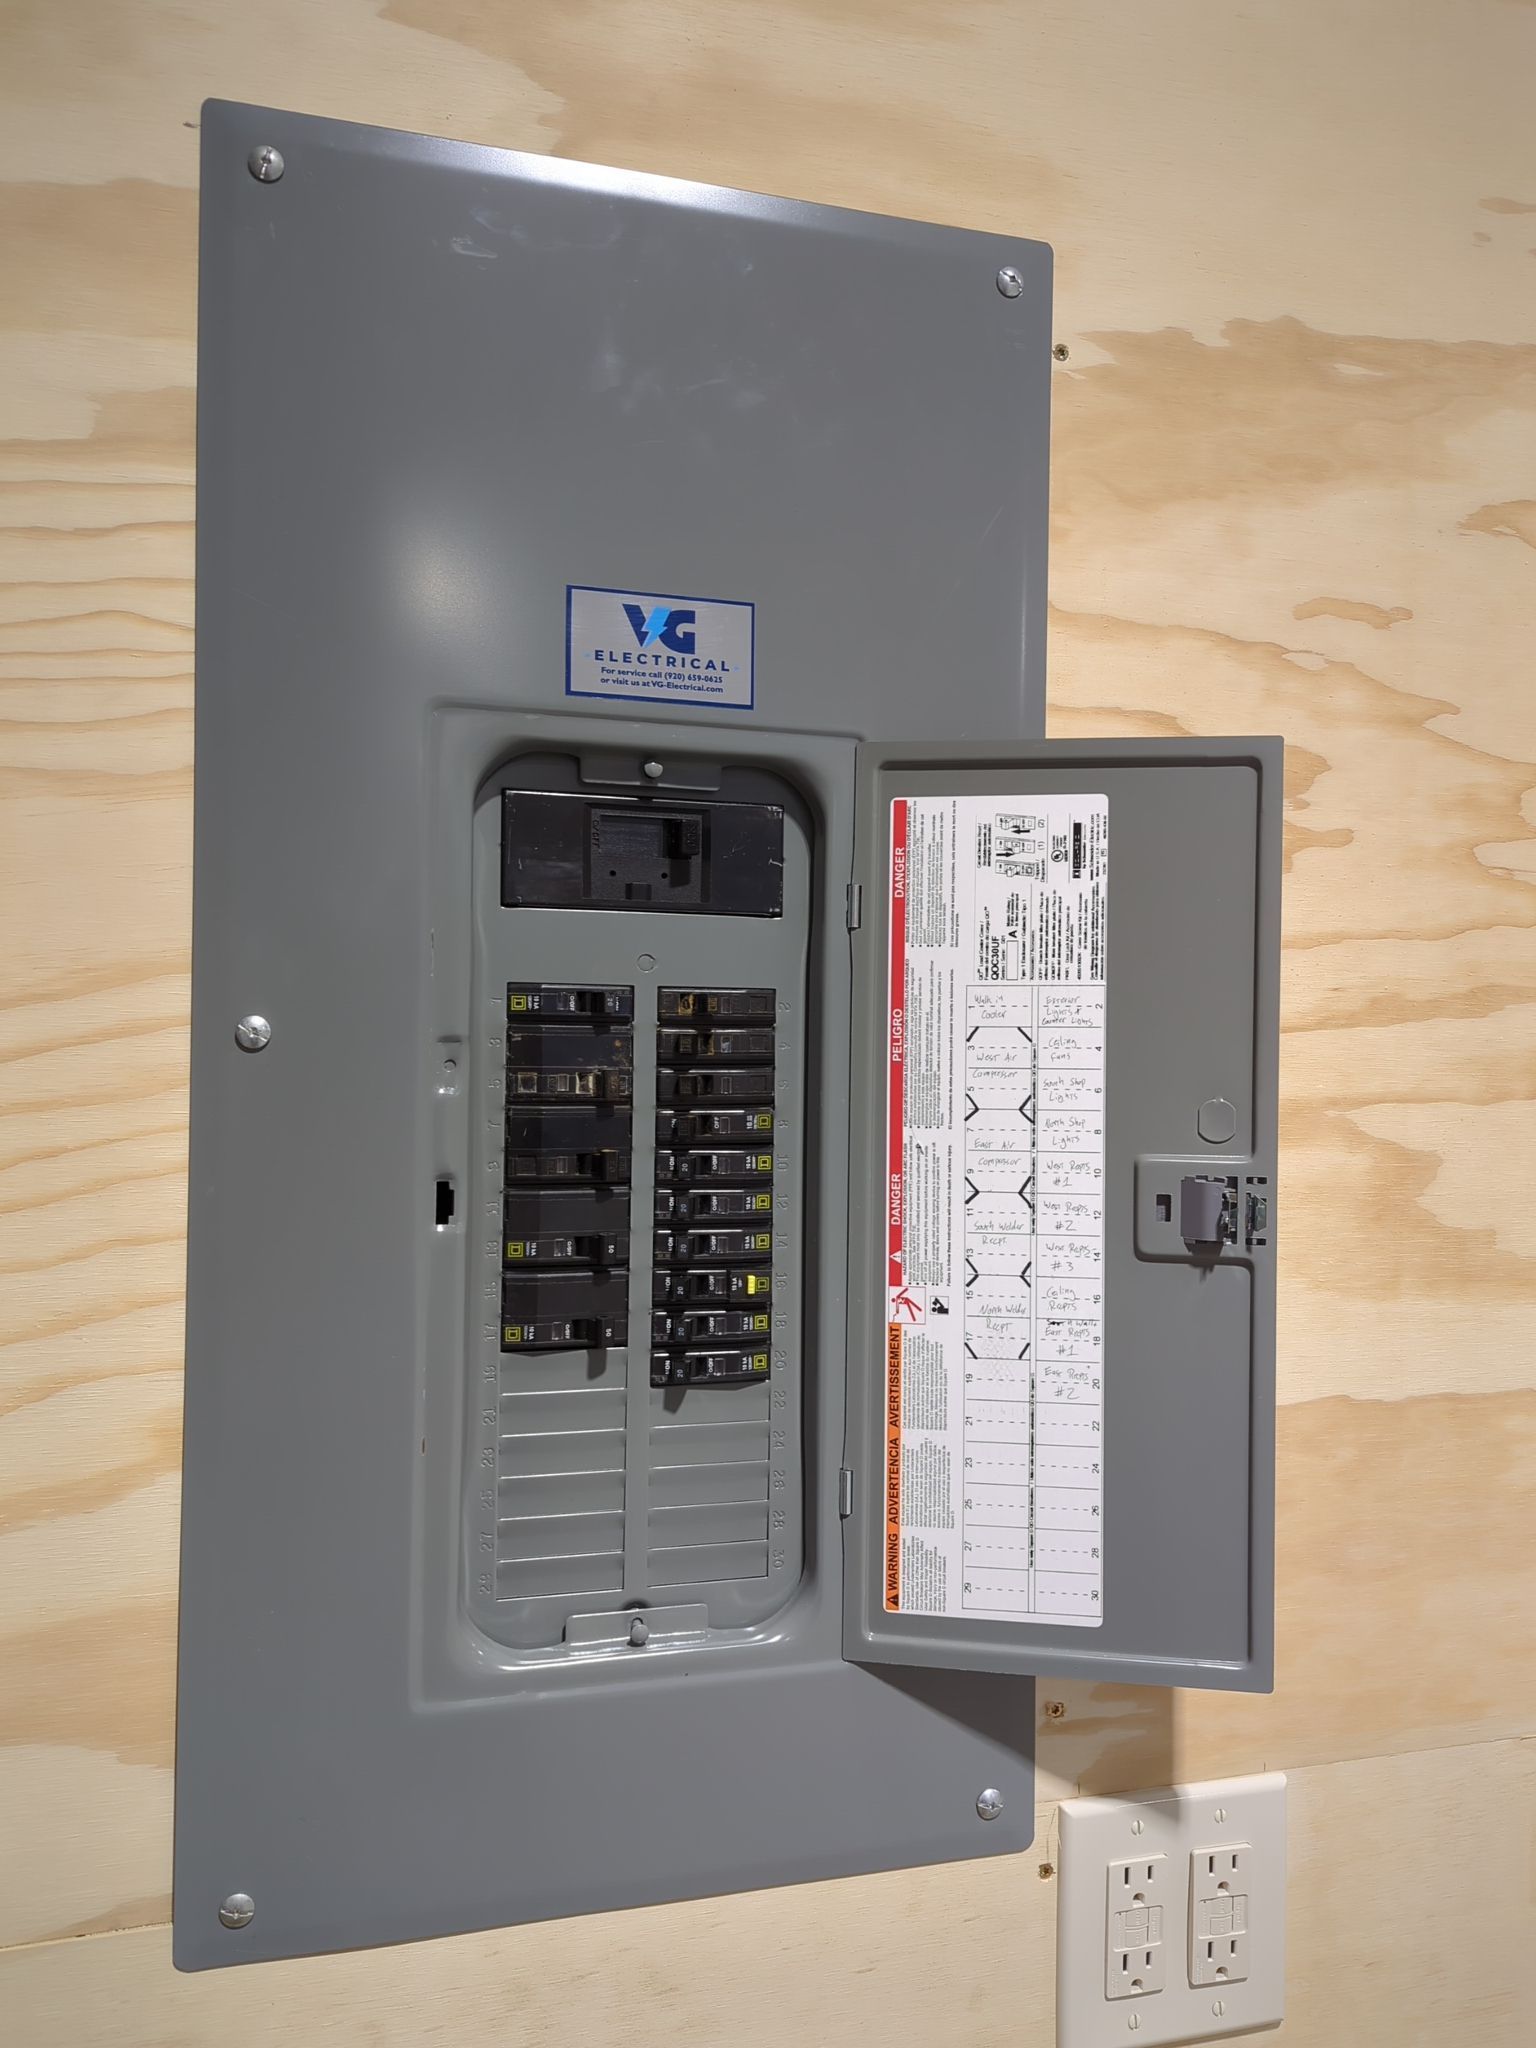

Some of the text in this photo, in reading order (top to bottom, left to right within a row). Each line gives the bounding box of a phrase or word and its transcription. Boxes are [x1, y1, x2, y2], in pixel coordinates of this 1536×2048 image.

[622, 603, 695, 655] VG
[594, 649, 730, 672] ELECTRICAL
[601, 666, 723, 685] For service call (920) 659-0625
[610, 677, 630, 686] visit
[631, 679, 641, 687] us
[641, 680, 651, 688] at
[651, 680, 724, 694] VG-Electrical.com
[1037, 819, 1045, 829] (2)
[1037, 841, 1045, 851] (1)
[894, 847, 905, 898] DANGER
[1008, 930, 1018, 939] A
[991, 935, 1000, 981] QOC30UF
[893, 1008, 903, 1062] PELIGRO
[1094, 1168, 1101, 1178] 10
[891, 1174, 901, 1226] DANGER
[966, 1208, 974, 1217] 11
[1093, 1210, 1101, 1220] 12
[966, 1248, 974, 1258] 13
[1093, 1252, 1101, 1262] 14
[677, 1285, 684, 1295] 20
[966, 1290, 974, 1300] 15
[1093, 1294, 1101, 1304] 16
[966, 1332, 974, 1341] 17
[1093, 1336, 1101, 1346] 18
[965, 1373, 973, 1383] 19
[1092, 1378, 1100, 1389] 20
[965, 1416, 973, 1426] 21
[1092, 1420, 1100, 1431] 22
[887, 1327, 899, 1591] WARNING ADVERTENCIA AVERTISSEMENT
[965, 1457, 972, 1468] 23
[1092, 1463, 1099, 1474] 24
[965, 1499, 972, 1510] 25
[1092, 1505, 1099, 1516] 26
[964, 1541, 972, 1551] 27
[1092, 1548, 1099, 1559] 28
[964, 1583, 972, 1593] 29
[1092, 1589, 1099, 1601] 30
